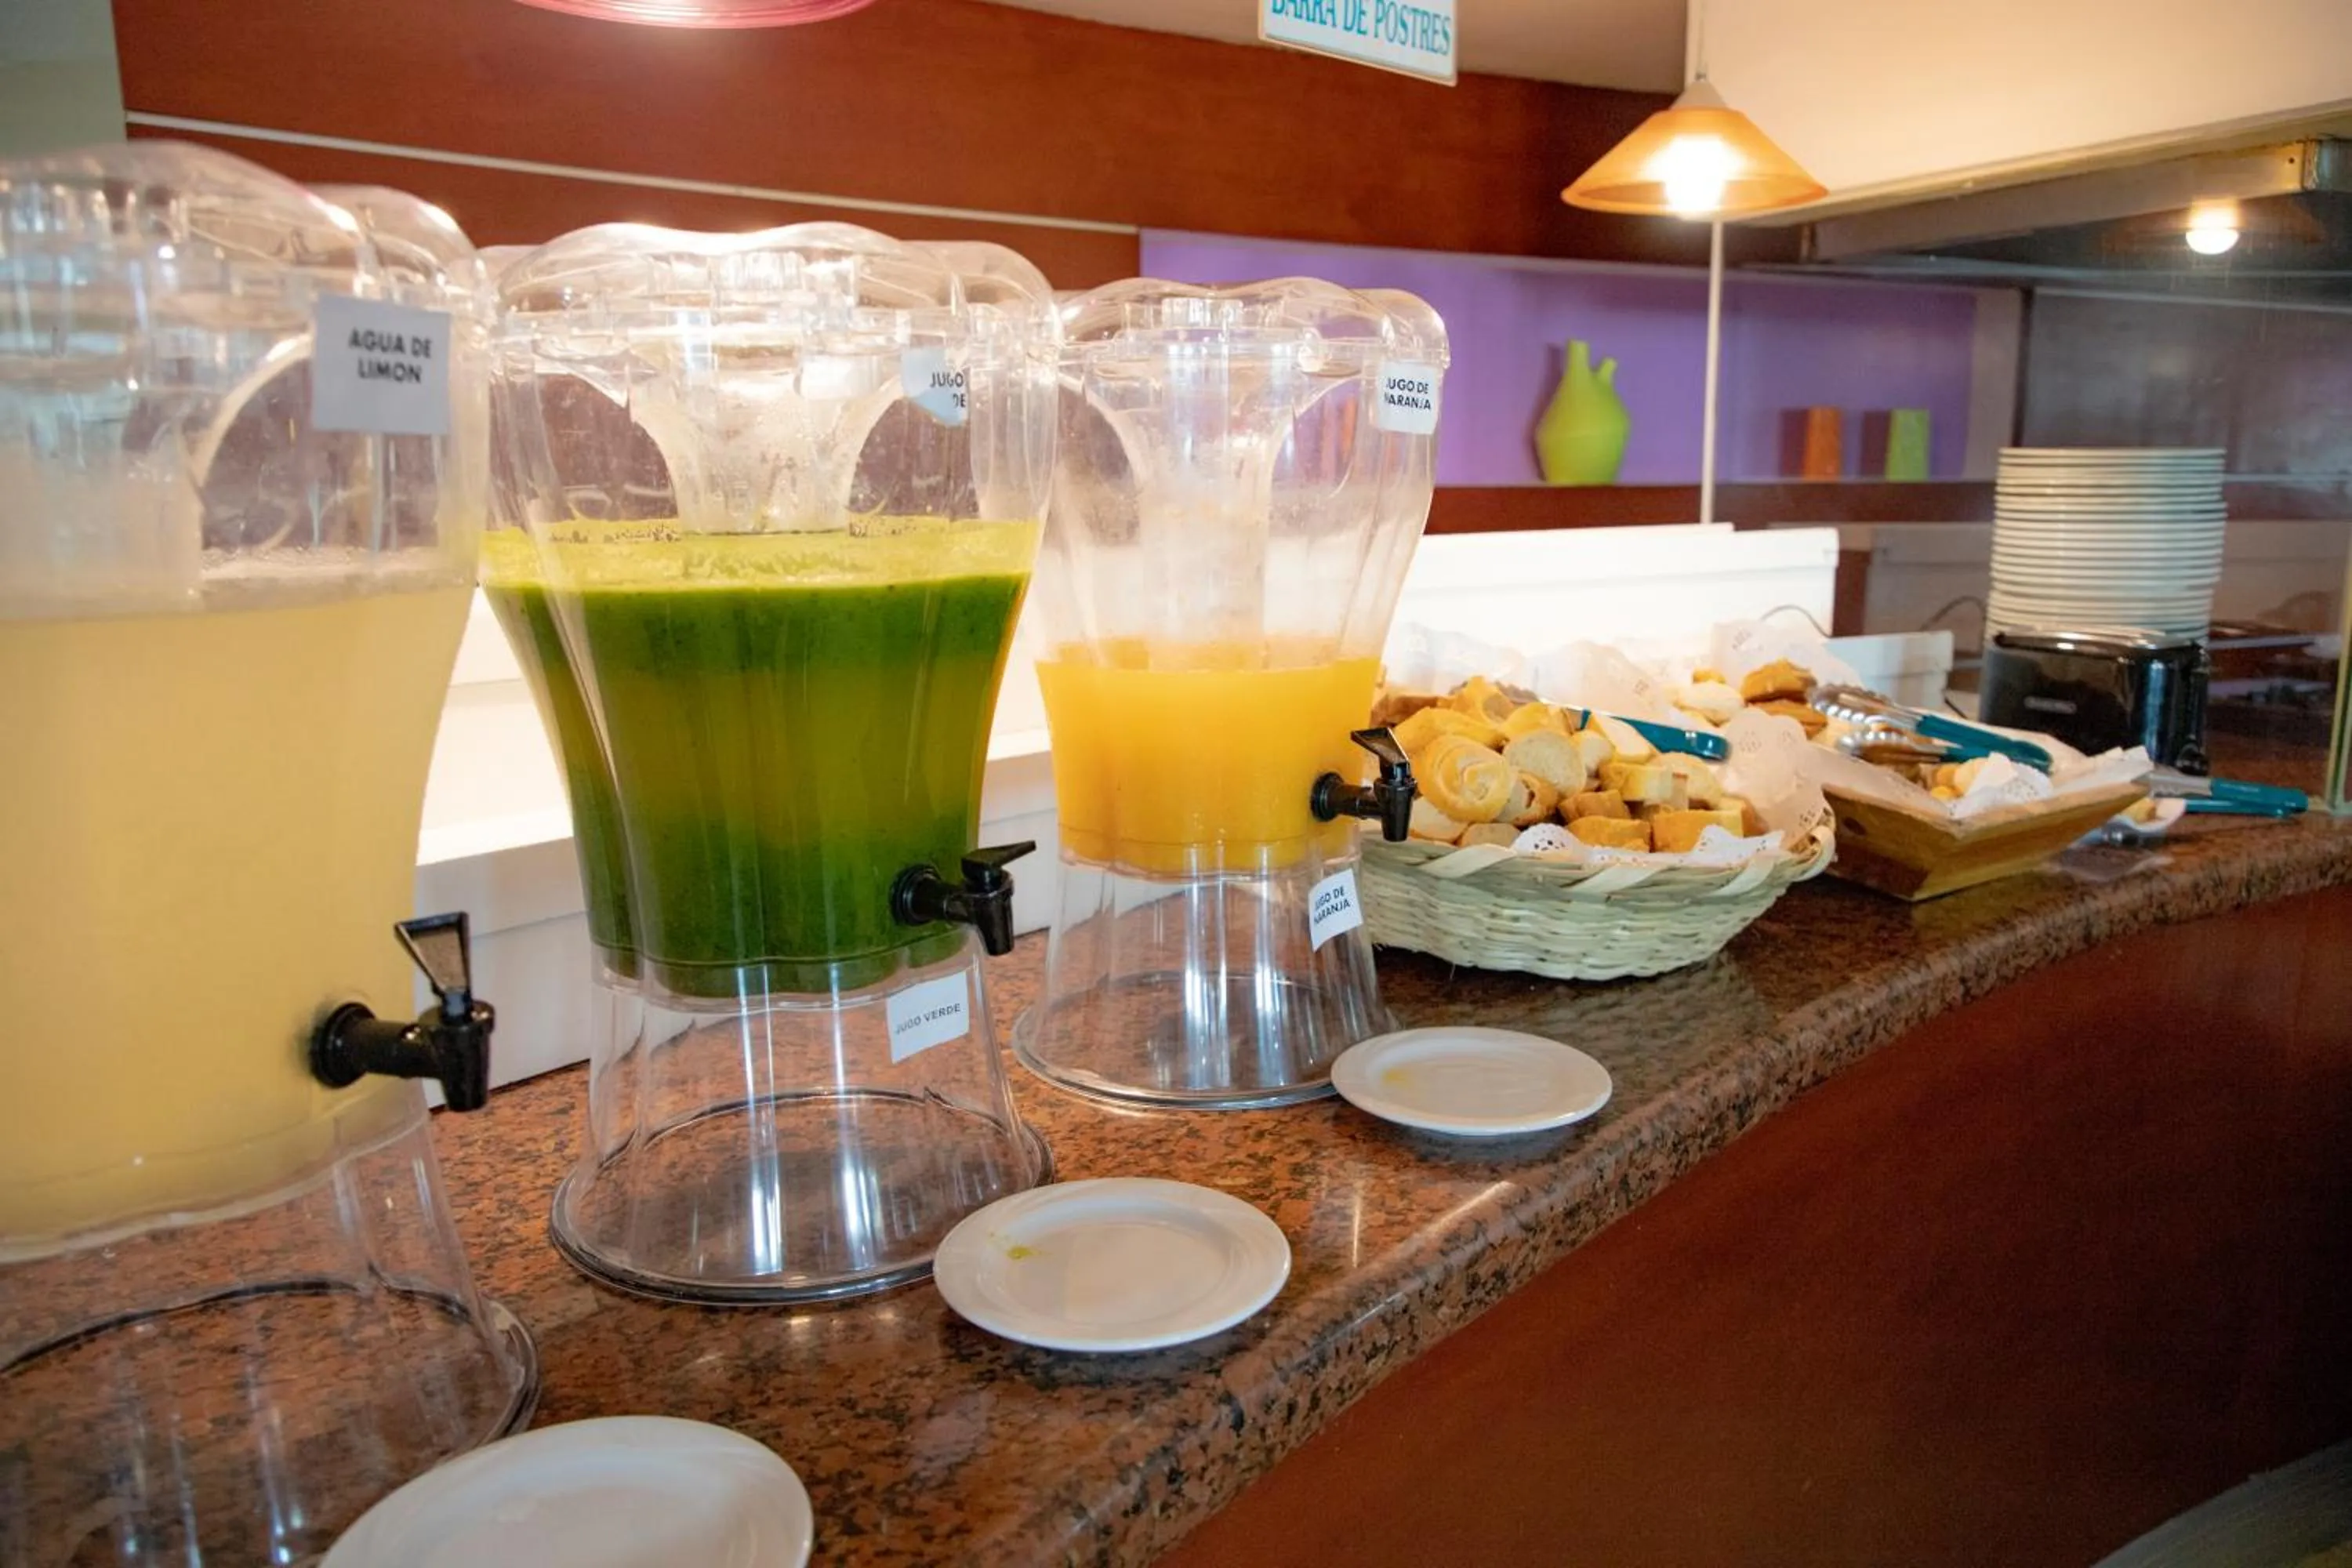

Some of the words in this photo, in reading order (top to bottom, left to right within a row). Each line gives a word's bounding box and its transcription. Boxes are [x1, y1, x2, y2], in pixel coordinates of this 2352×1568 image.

[1342, 0, 1368, 35] DE
[1374, 2, 1451, 56] POSTRES
[349, 327, 405, 354] AGUA
[412, 336, 433, 359] DE
[358, 358, 422, 383] LIMON
[930, 372, 964, 388] JUGO
[1386, 378, 1415, 392] UGO
[1417, 382, 1429, 394] DE
[1333, 886, 1345, 899] DE
[924, 1004, 961, 1022] VERDE
